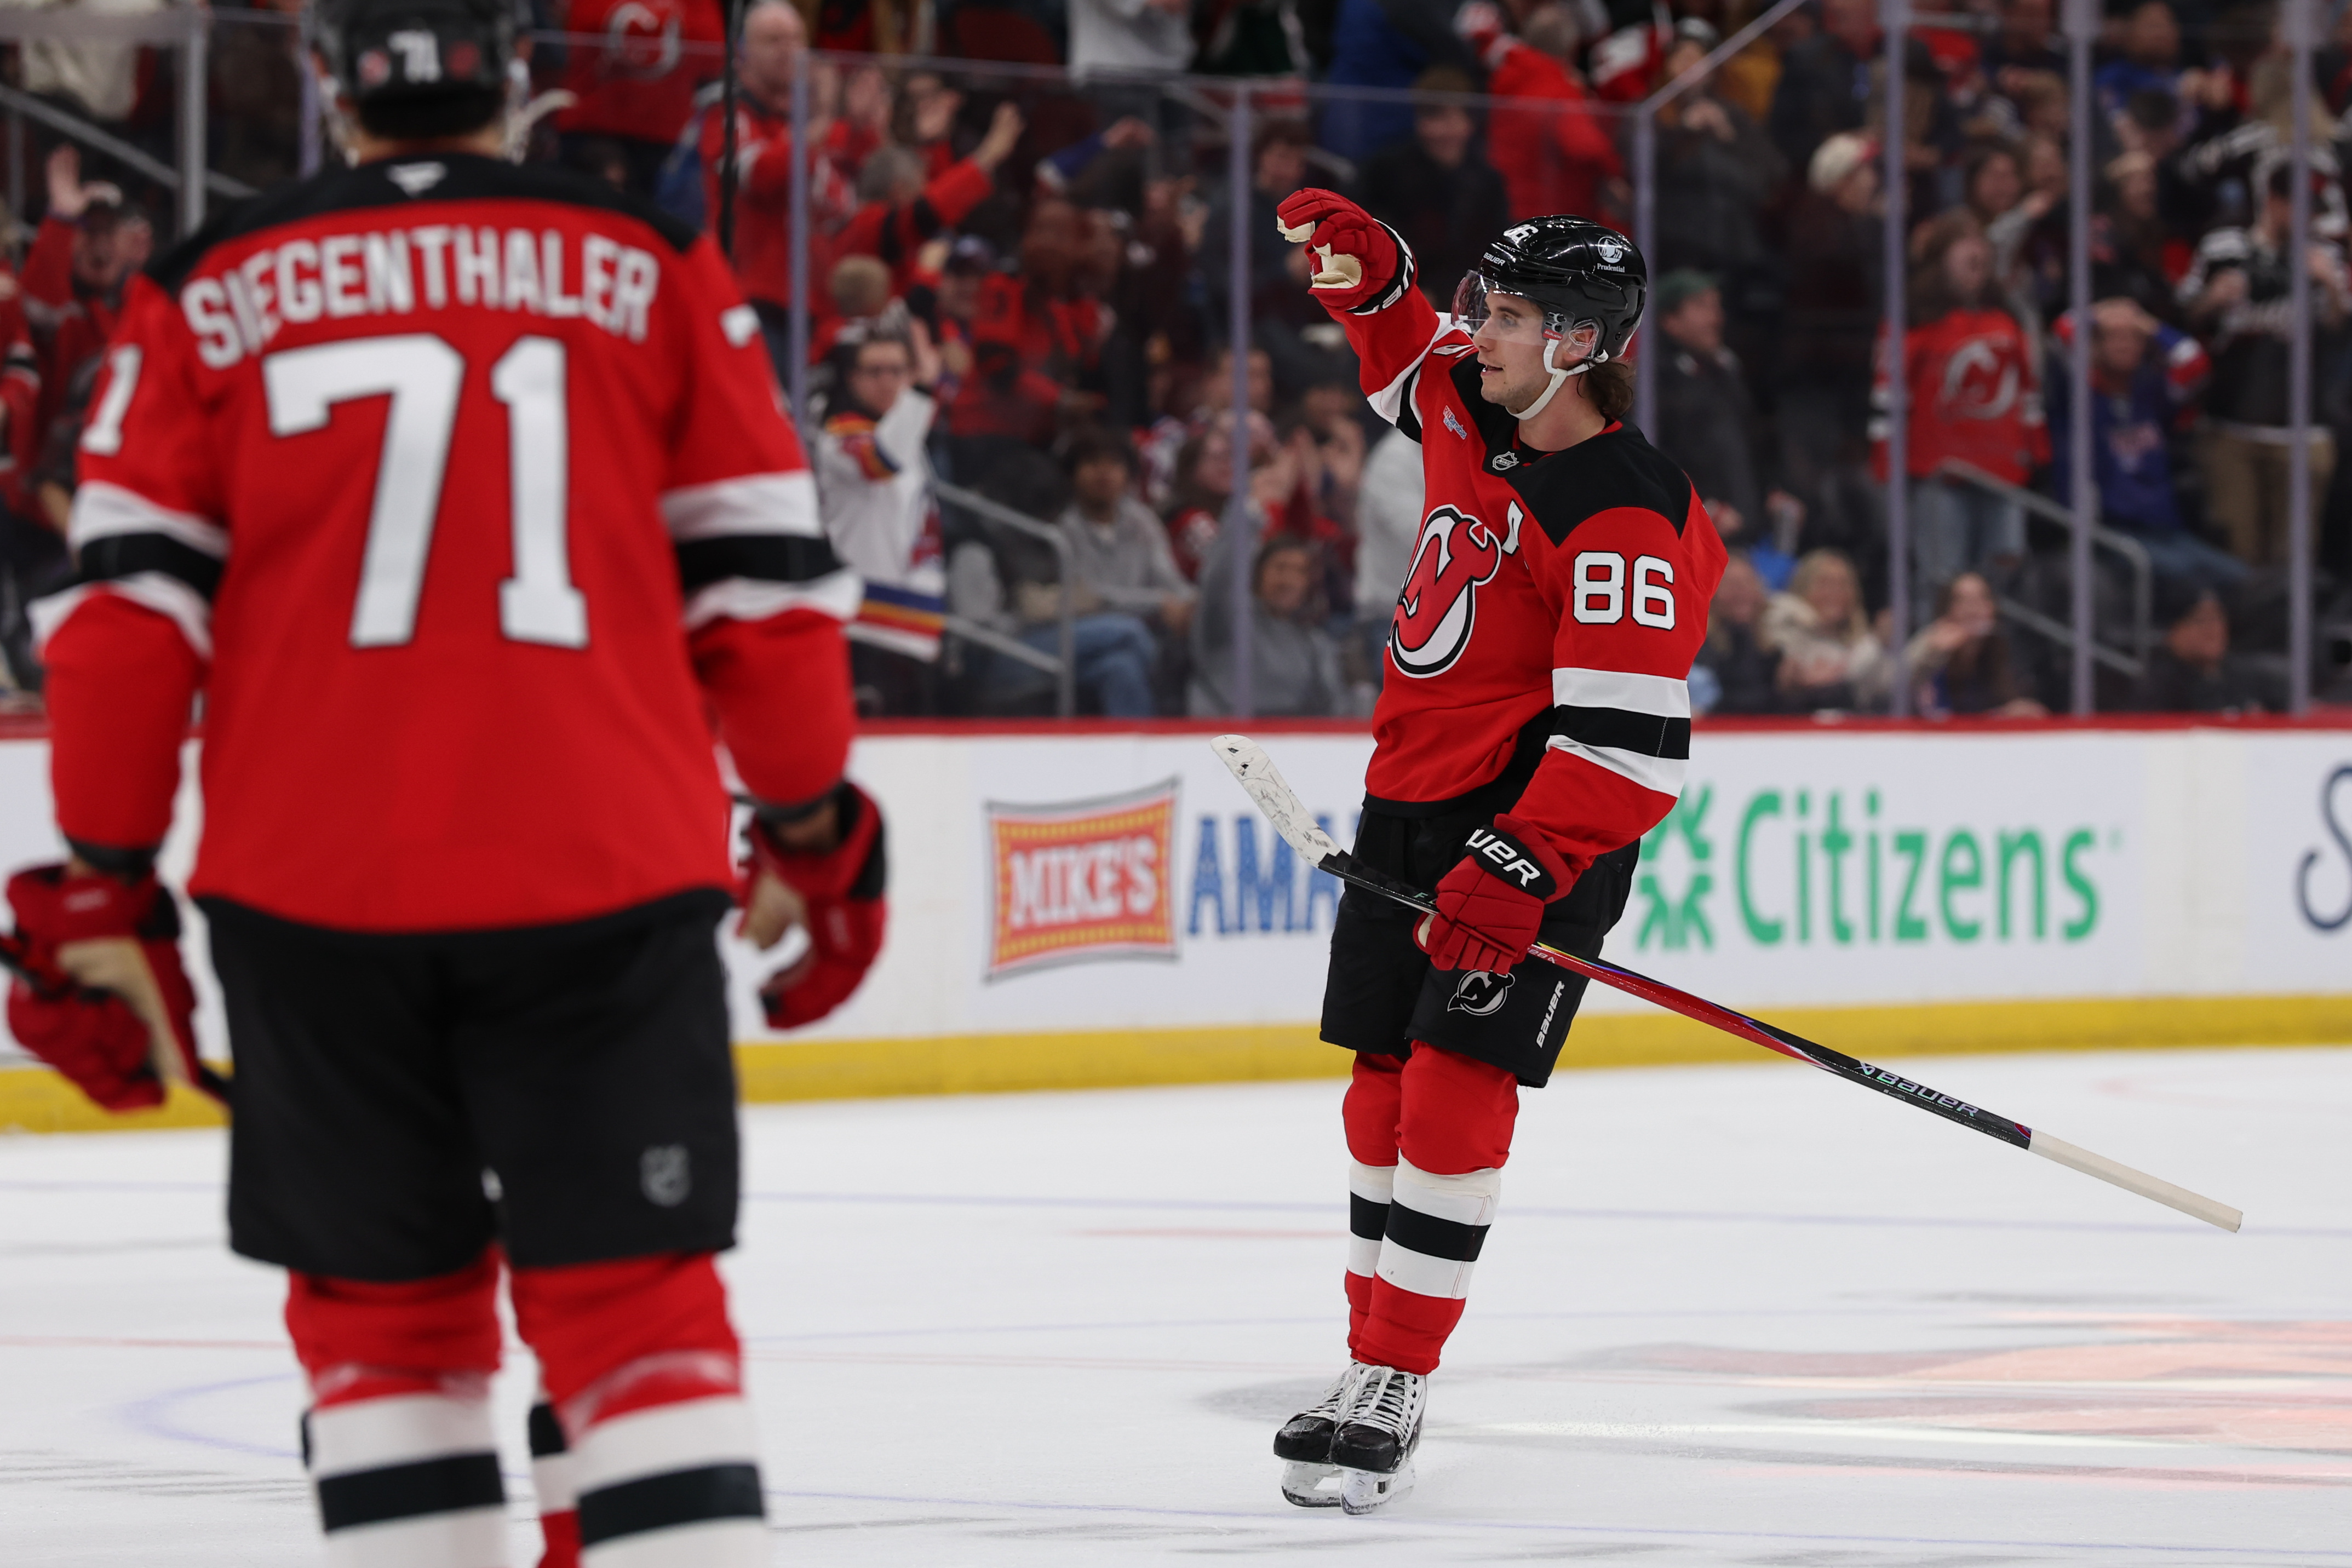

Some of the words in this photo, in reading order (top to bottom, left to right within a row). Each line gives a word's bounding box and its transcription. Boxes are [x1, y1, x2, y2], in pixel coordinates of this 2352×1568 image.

[1483, 252, 1506, 266] BAUER
[1597, 263, 1625, 273] Prudential
[181, 224, 659, 369] SIEGENTHALER
[263, 333, 589, 648] 71
[1573, 551, 1675, 630] 86
[1007, 835, 1158, 928] MIKE'S
[1188, 814, 1365, 934] AMA
[1735, 784, 2101, 945] Citizens
[1536, 980, 1565, 1048] BAUER
[1876, 1071, 1979, 1117] BAUER
[1919, 1103, 1962, 1123] TECHNOLOGY
[1964, 1121, 1985, 1133] TAPER
[1987, 1129, 2012, 1142] TWITCH
